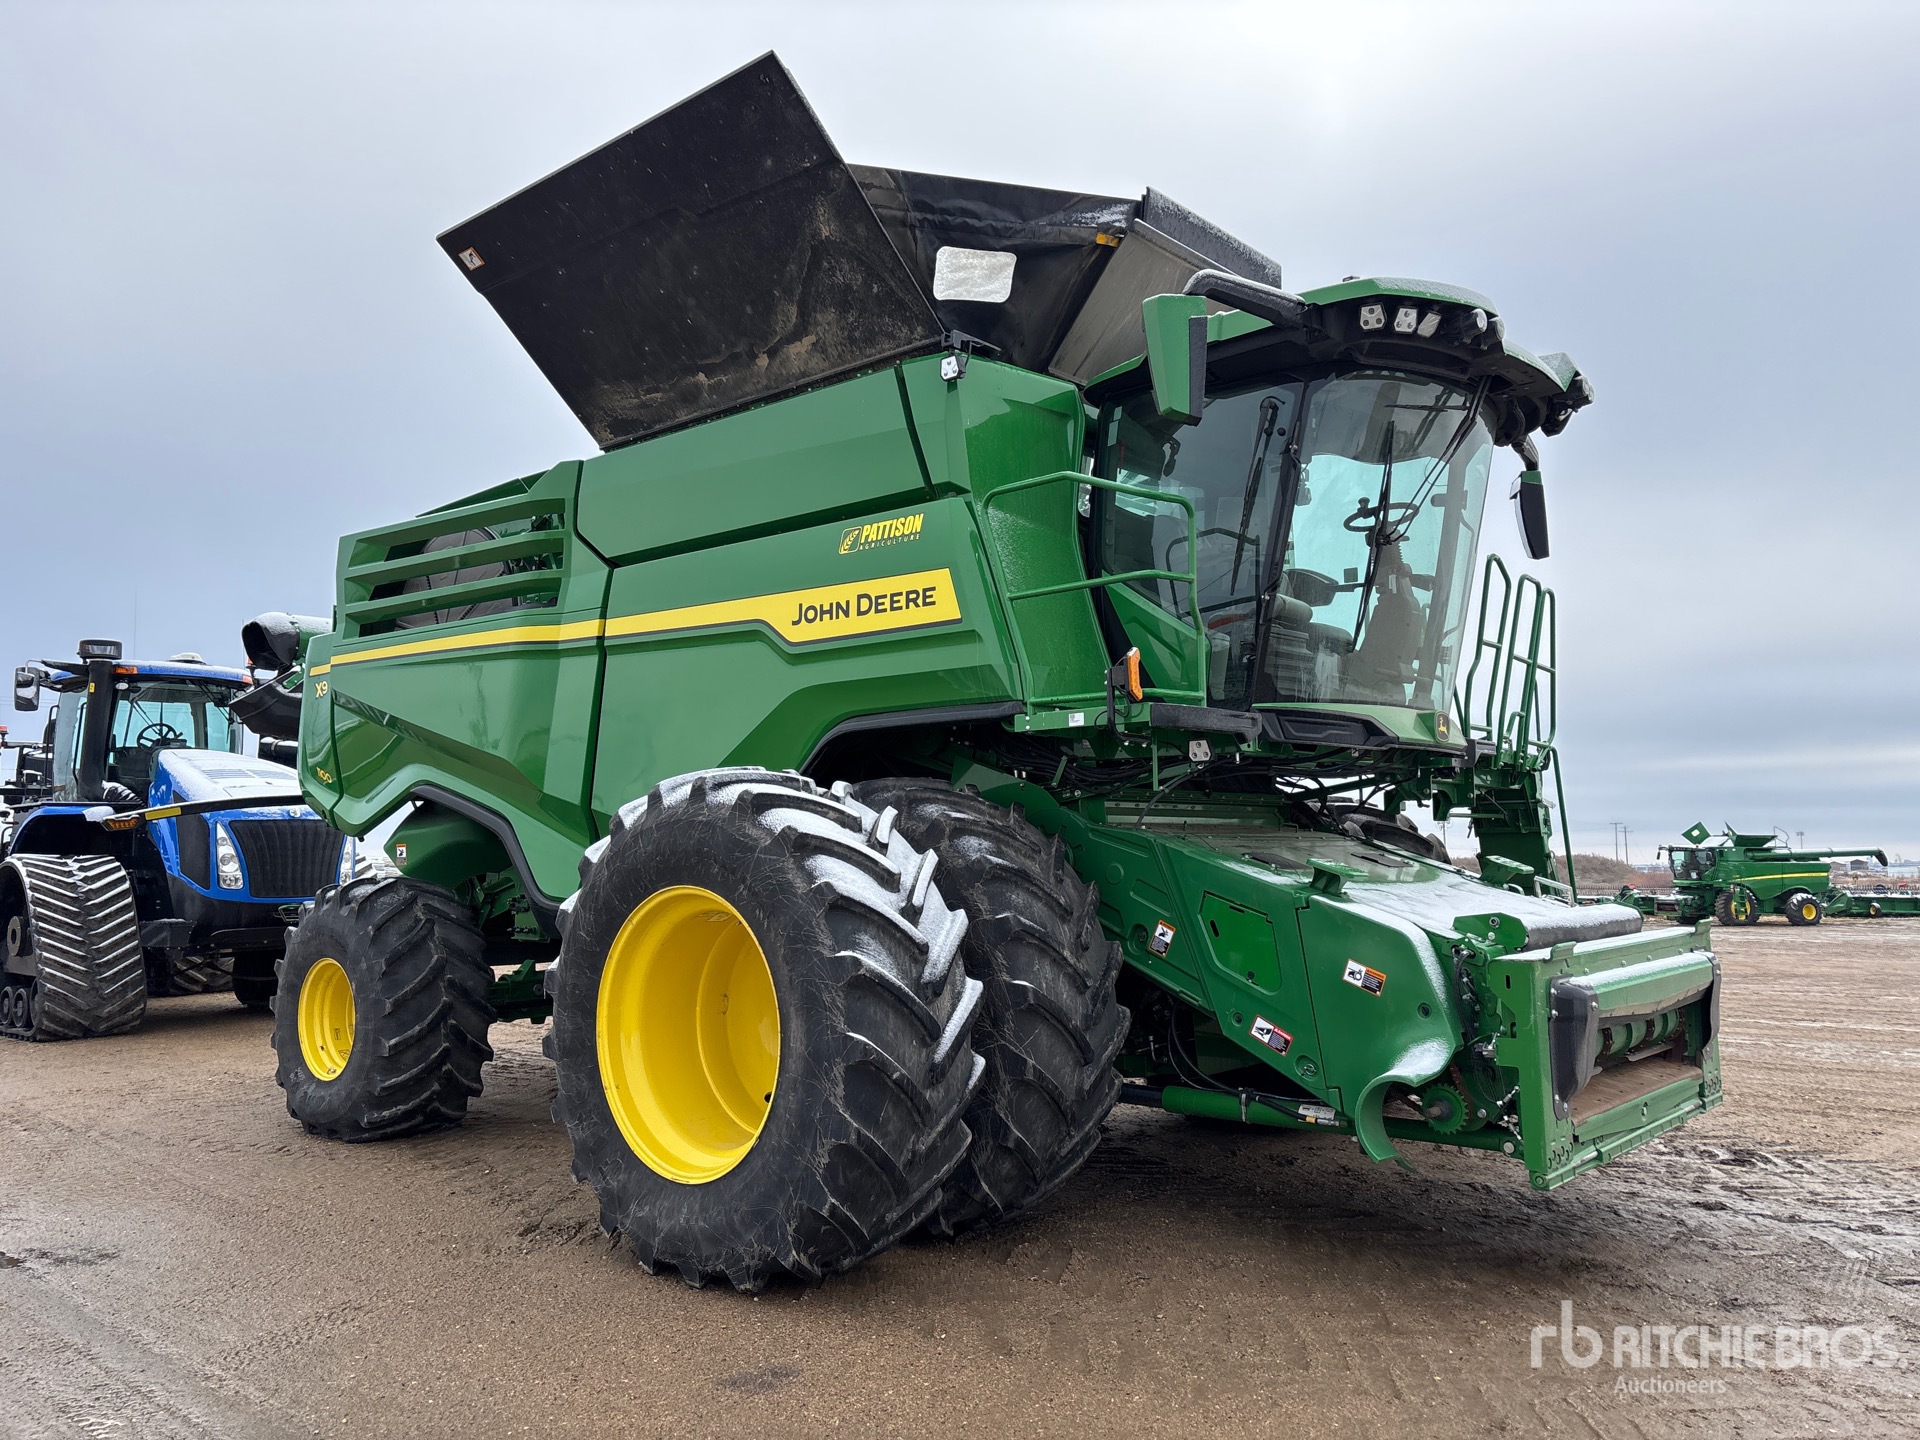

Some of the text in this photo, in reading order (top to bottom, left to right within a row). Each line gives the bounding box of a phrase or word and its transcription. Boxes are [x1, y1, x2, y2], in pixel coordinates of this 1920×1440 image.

[860, 513, 924, 543] PATTISON
[859, 534, 920, 550] AGRICULTURE
[791, 586, 936, 626] JOHN DEERE
[314, 680, 328, 698] X9
